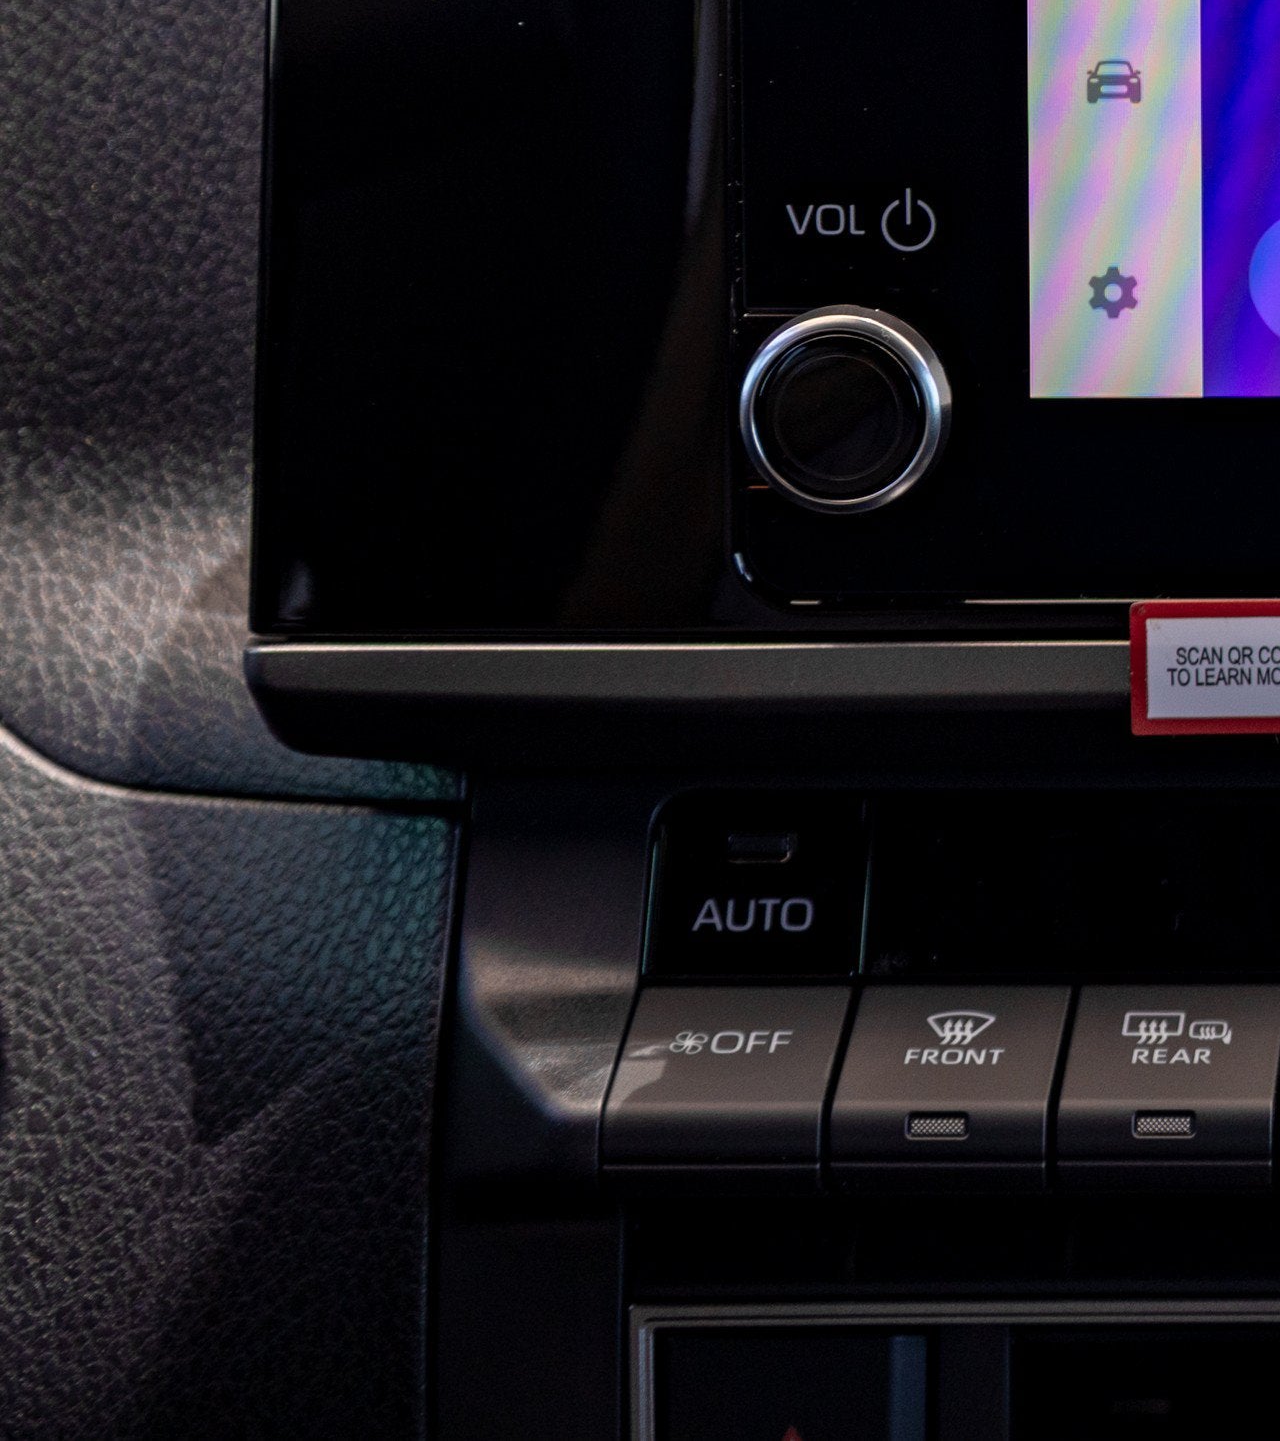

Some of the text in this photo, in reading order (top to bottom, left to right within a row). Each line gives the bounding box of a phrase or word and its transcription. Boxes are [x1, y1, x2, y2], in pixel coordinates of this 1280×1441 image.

[785, 203, 866, 236] VOL
[1175, 645, 1224, 665] SCAN
[1227, 645, 1255, 666] QR
[1166, 667, 1191, 687] TO
[1195, 667, 1251, 686] LEARN
[691, 897, 815, 933] AUTO
[709, 1029, 795, 1056] OFF
[903, 1047, 1005, 1066] FRONT
[1130, 1047, 1213, 1065] REAR
